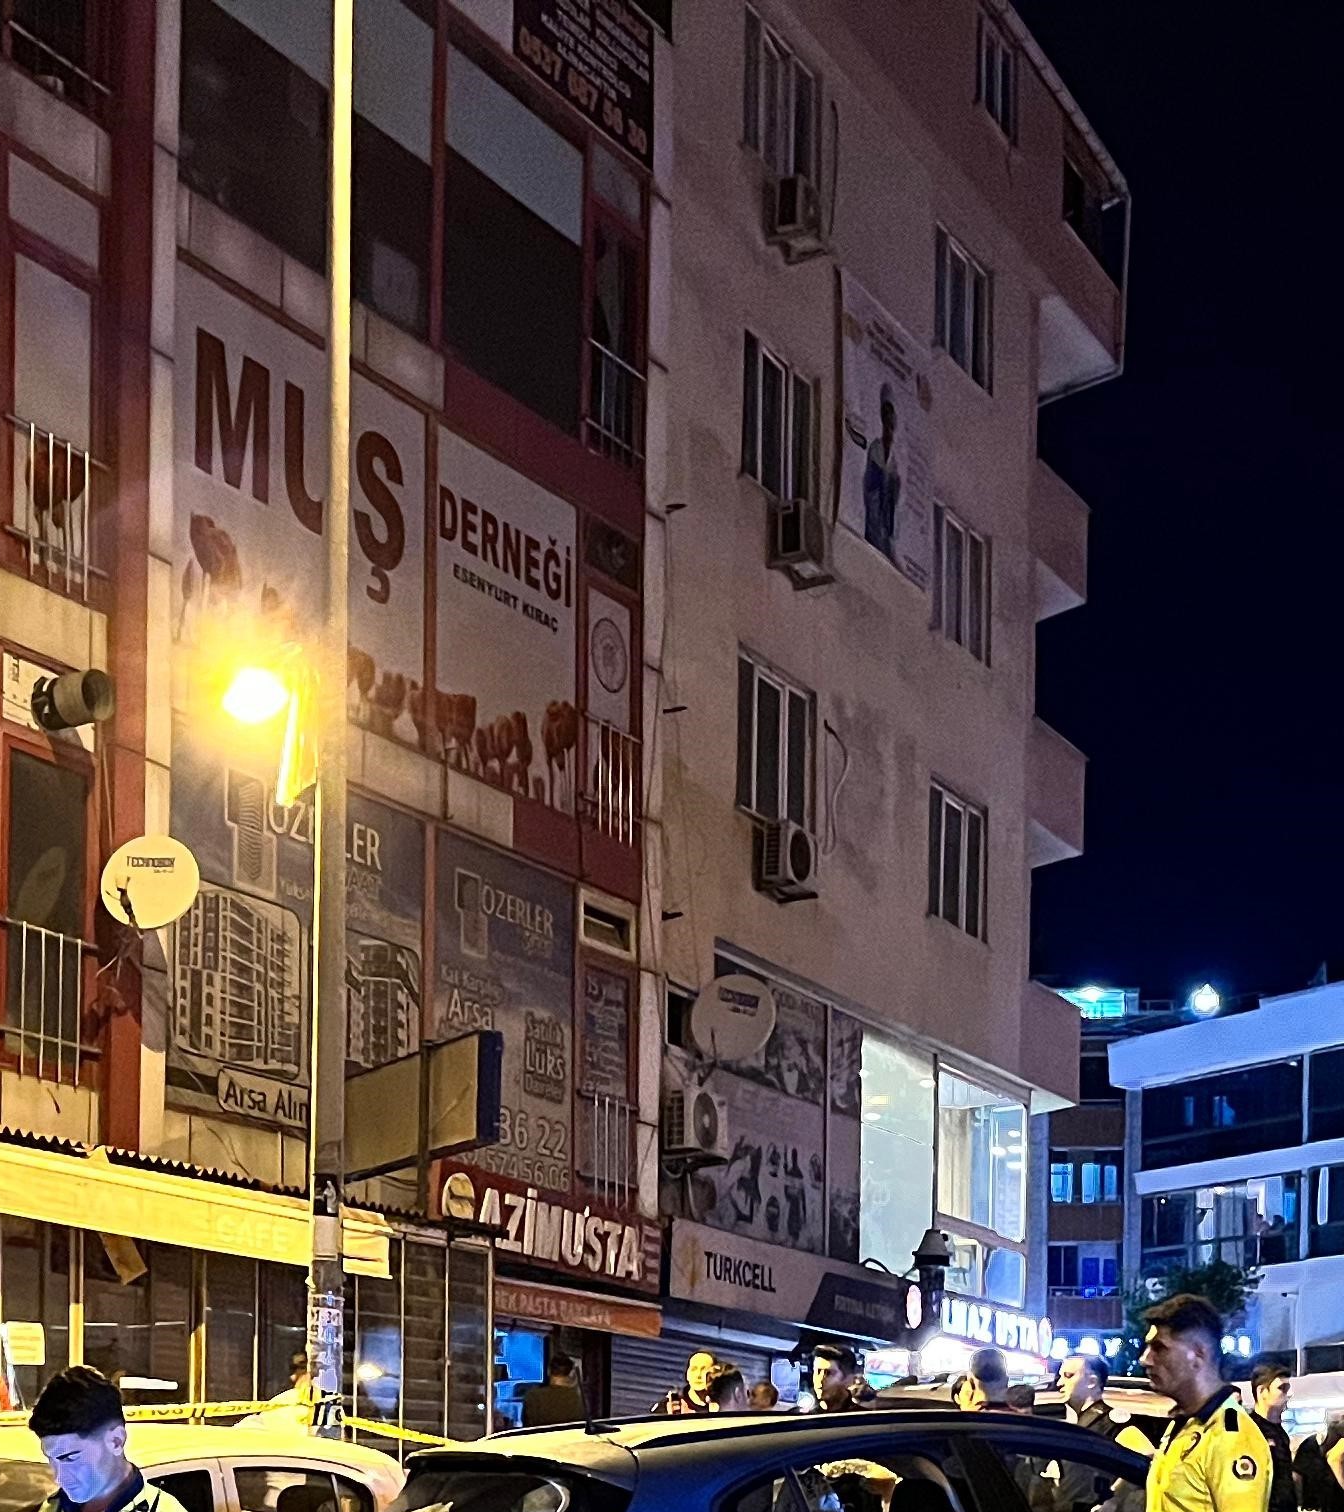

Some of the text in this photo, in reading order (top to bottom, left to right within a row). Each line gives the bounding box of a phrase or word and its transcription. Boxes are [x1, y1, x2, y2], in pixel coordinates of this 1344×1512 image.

[194, 325, 573, 609] MUŞ DERNEĞİ
[452, 562, 519, 611] ESENYURT
[481, 879, 554, 939] ÖZERLER
[448, 988, 493, 1031] Arsa
[223, 1076, 267, 1113] Arsa
[536, 1116, 567, 1161] 22
[703, 1250, 777, 1294] TURKCELL
